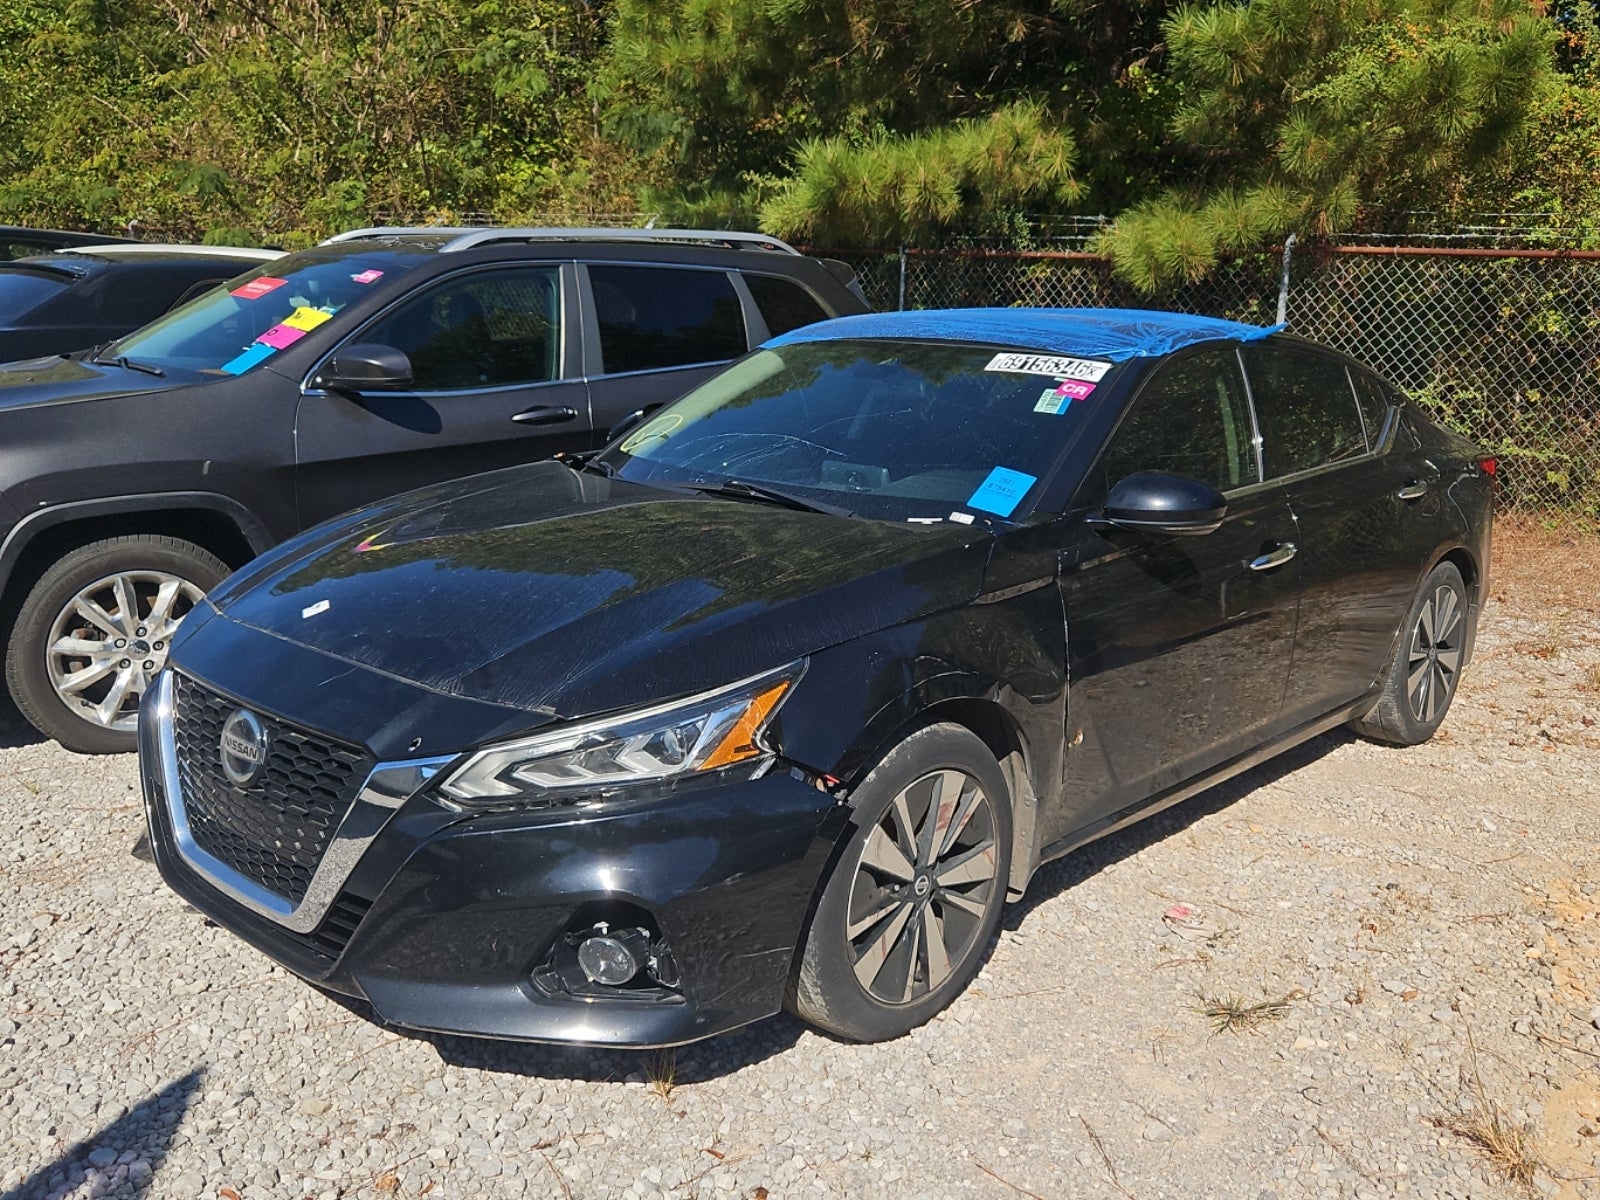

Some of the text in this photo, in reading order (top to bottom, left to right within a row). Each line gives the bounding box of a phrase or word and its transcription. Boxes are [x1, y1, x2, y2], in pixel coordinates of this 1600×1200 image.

[1000, 355, 1088, 377] 69156346
[1062, 383, 1089, 397] CR
[223, 735, 258, 759] NISSAN
